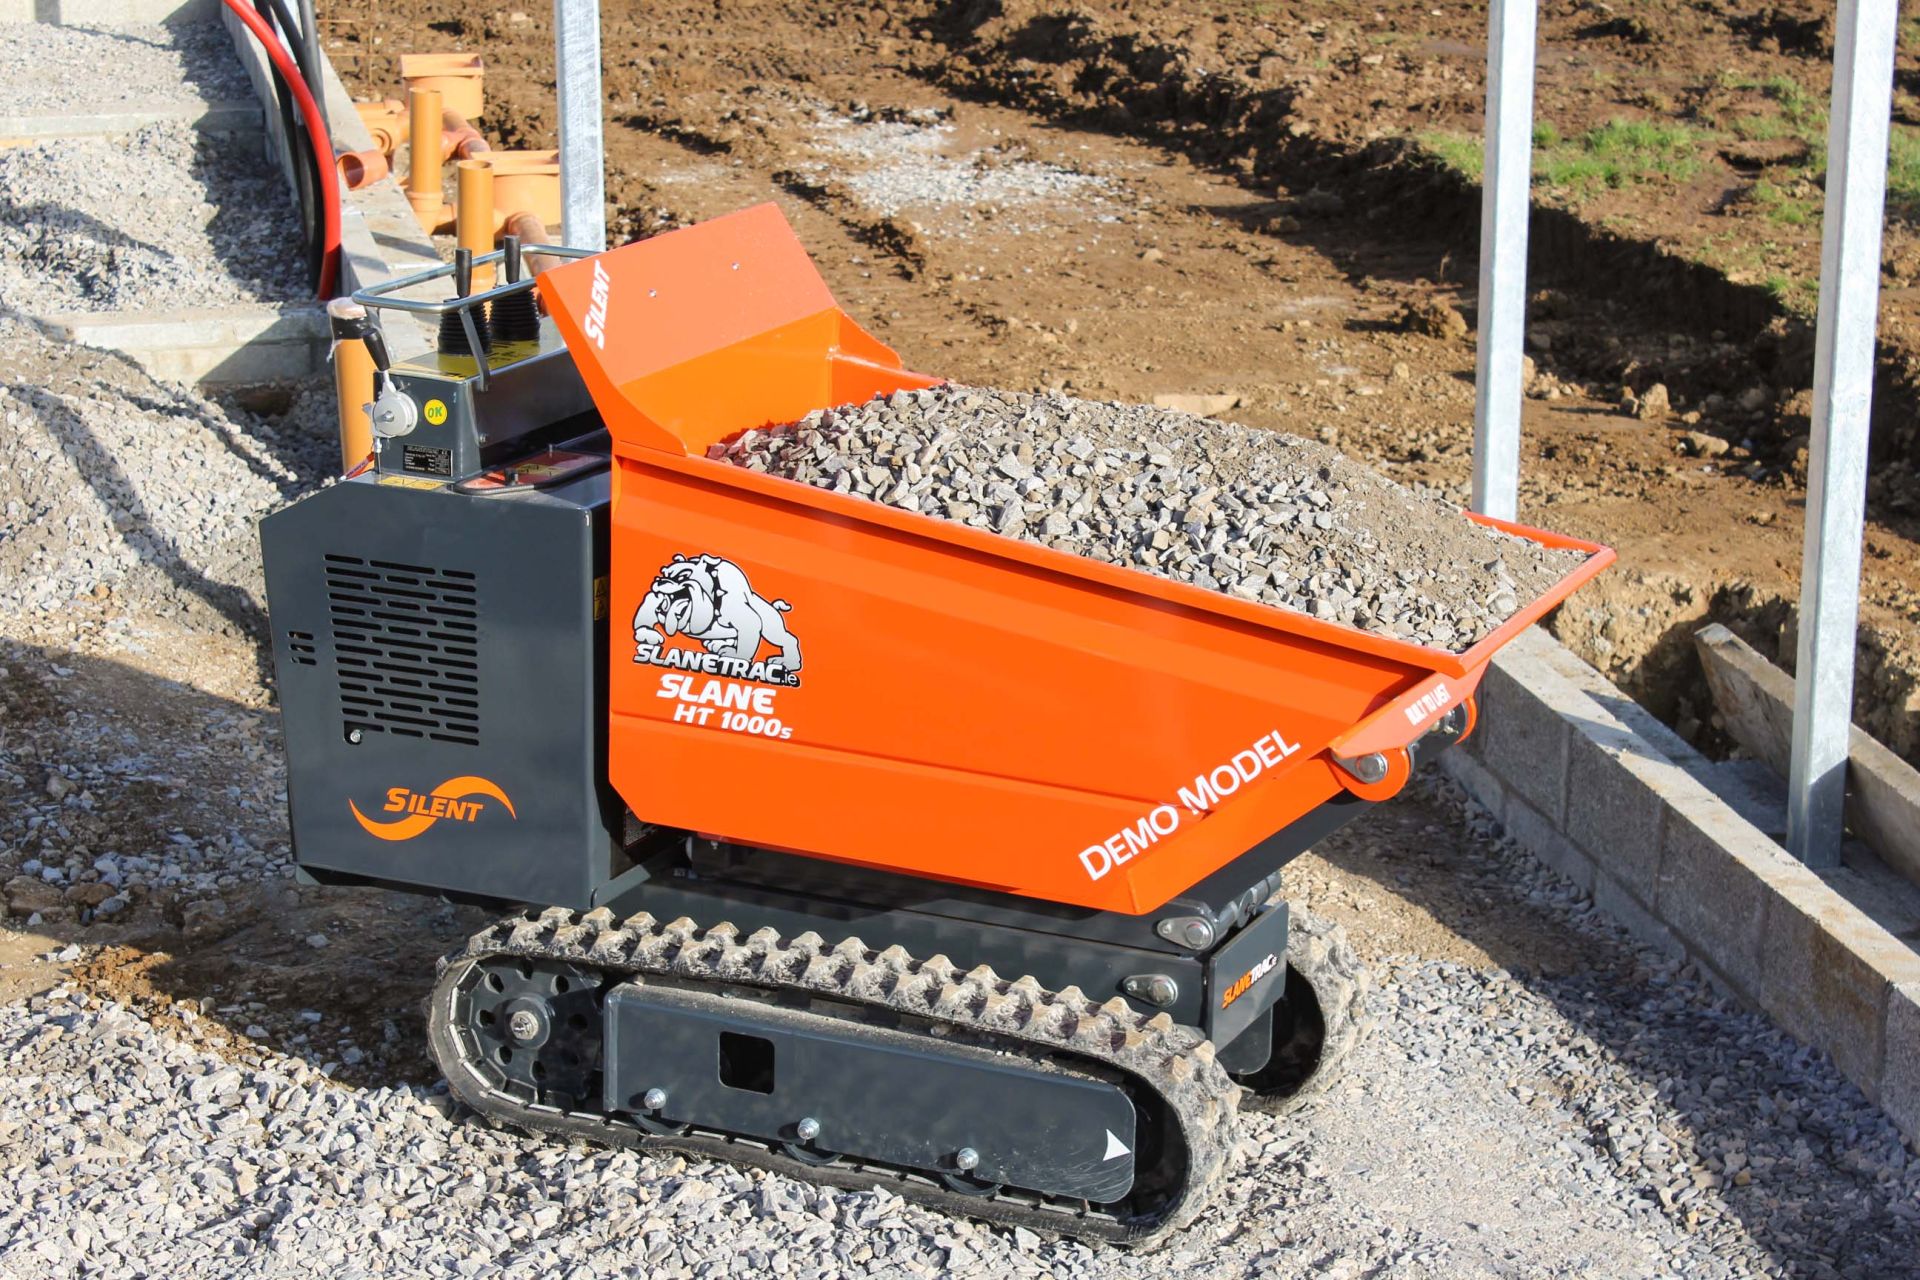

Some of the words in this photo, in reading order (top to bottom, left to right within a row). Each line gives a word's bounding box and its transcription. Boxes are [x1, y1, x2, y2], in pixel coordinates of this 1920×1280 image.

[584, 259, 610, 351] SILENT
[427, 406, 443, 418] OK
[632, 643, 799, 686] SLANETRAC.ie
[656, 673, 777, 715] SLANE
[673, 703, 715, 726] HT
[721, 711, 793, 739] 1000s
[383, 787, 484, 822] SILENT
[1078, 805, 1179, 881] DEMO
[1177, 729, 1301, 815] MODEL
